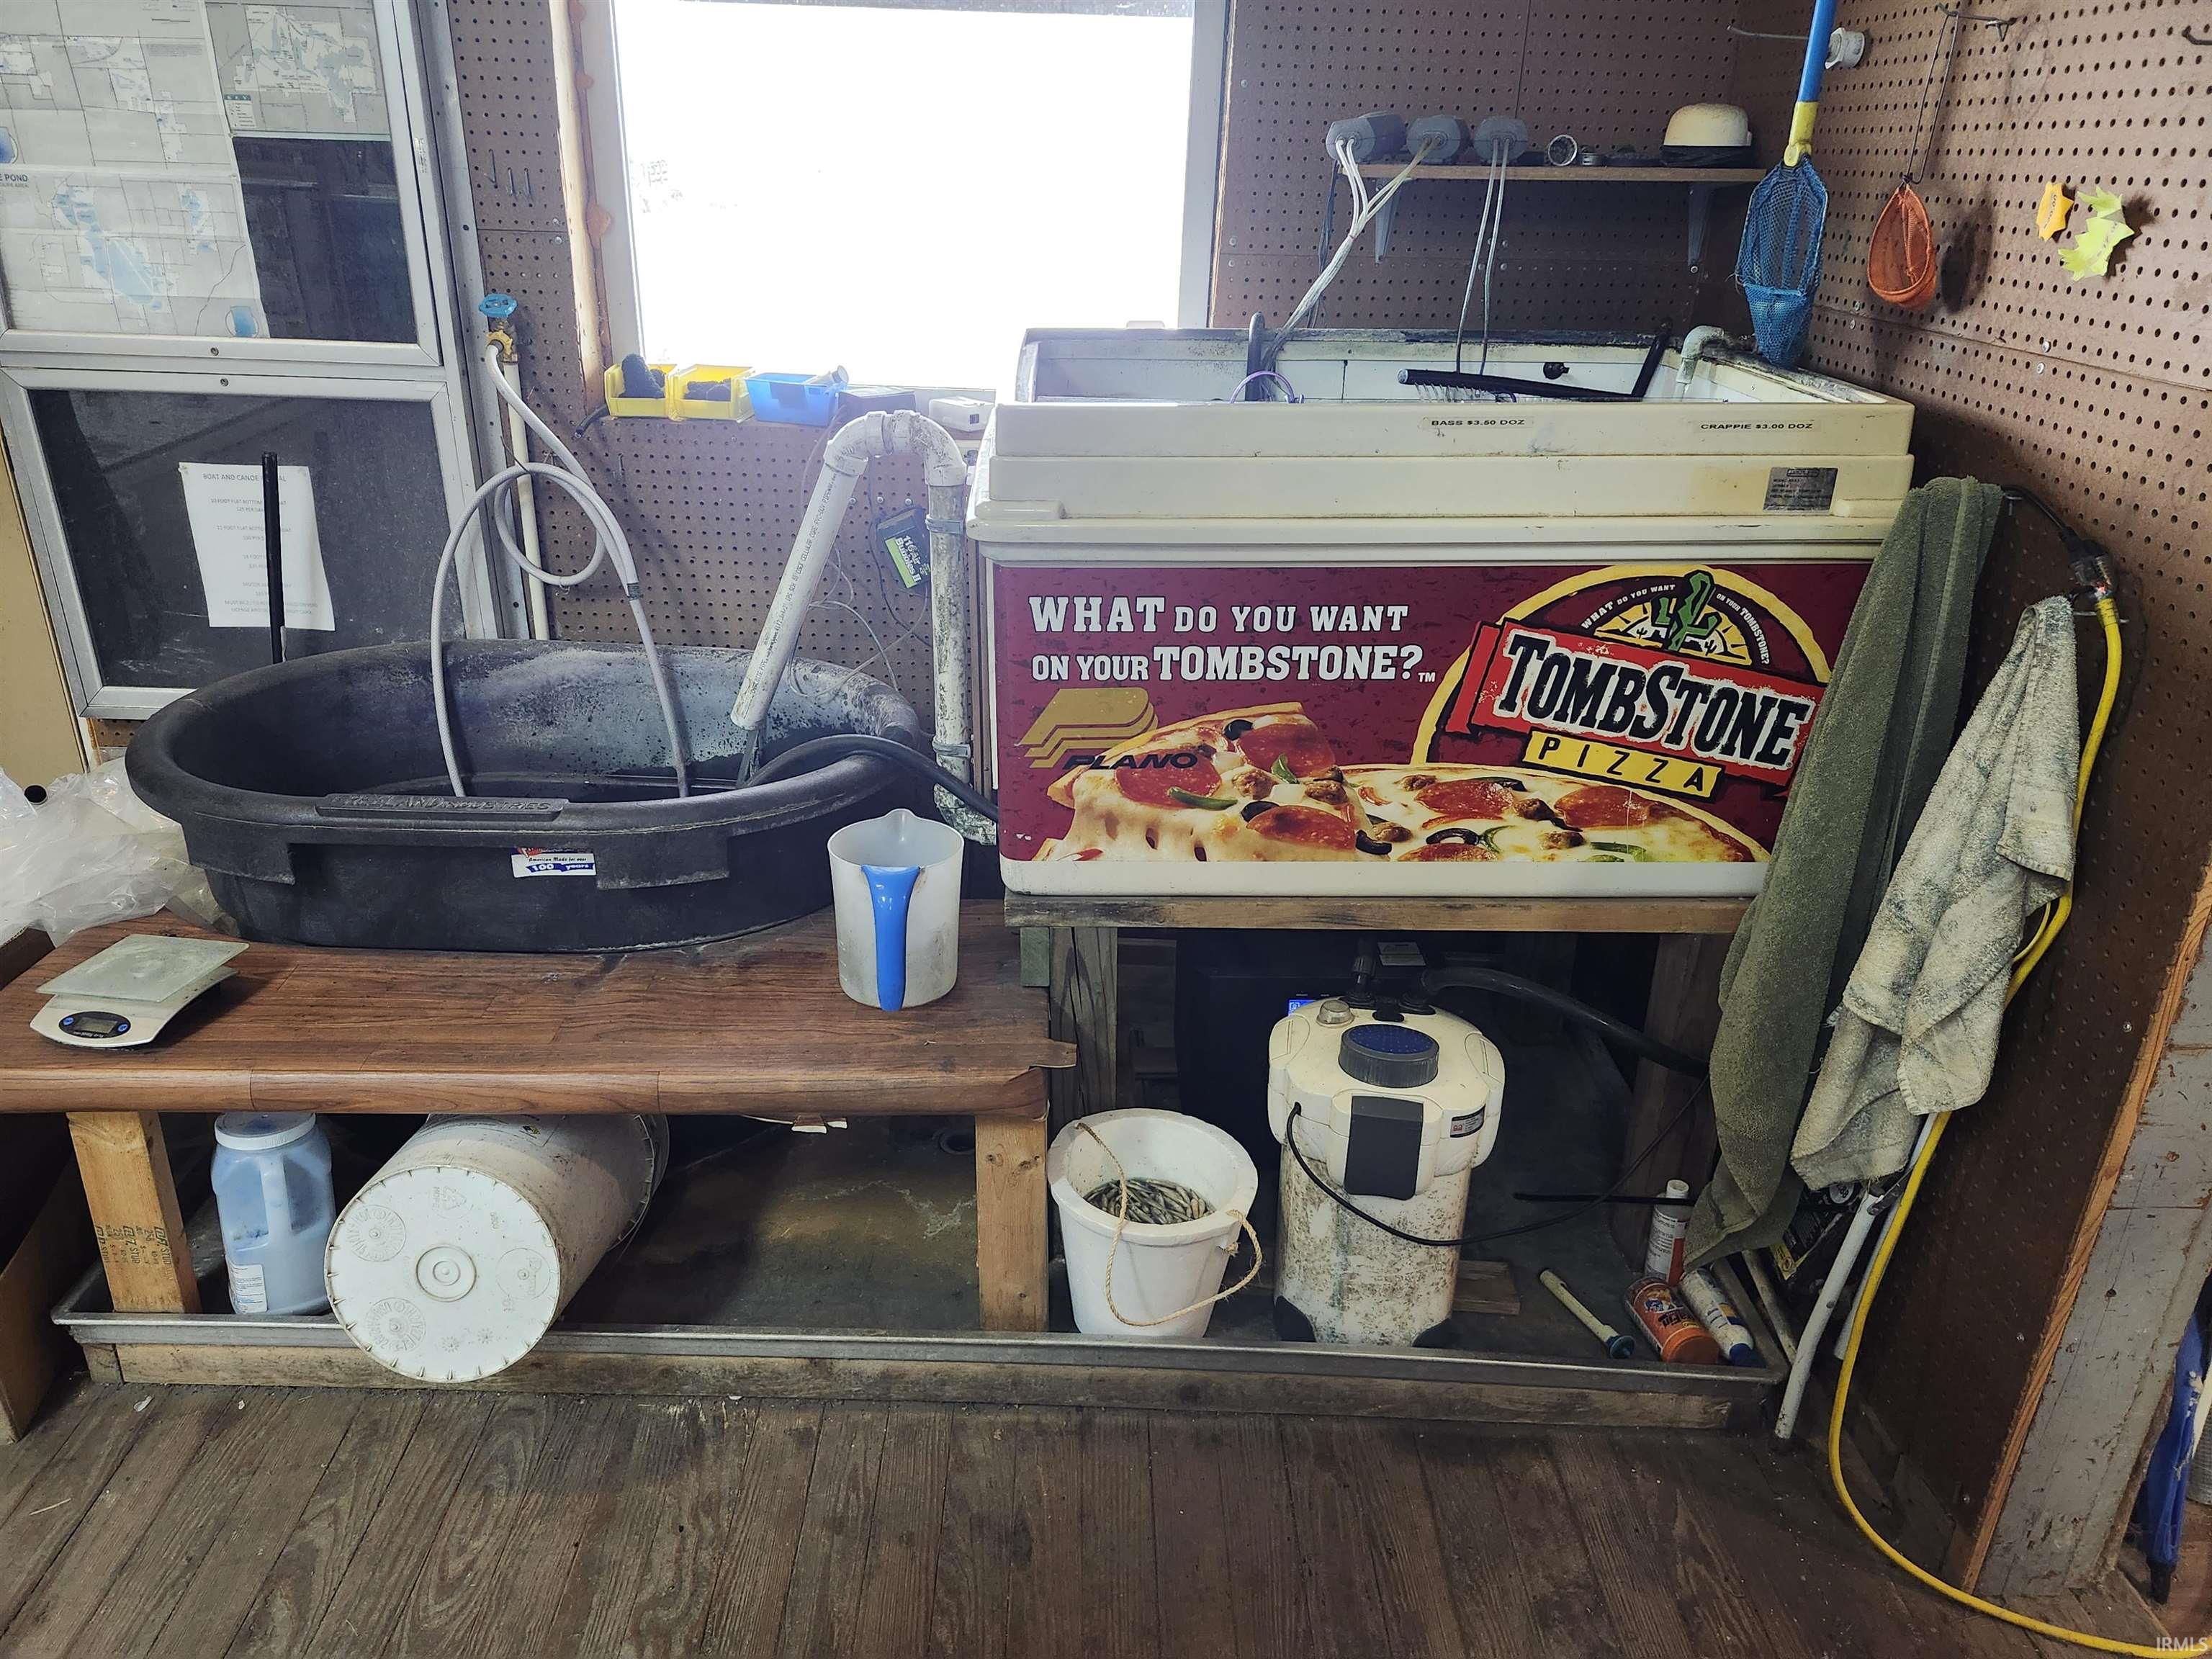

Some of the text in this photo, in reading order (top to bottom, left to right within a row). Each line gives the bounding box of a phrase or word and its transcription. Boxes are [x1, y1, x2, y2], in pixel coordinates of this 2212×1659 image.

[1028, 595, 1409, 633] WHAT DO YOU WANT
[1581, 584, 1771, 665] WHAT DO YOU WANT ON YOUR TOMBSTONE?
[1032, 655, 1070, 681] ON
[1076, 655, 1150, 681] YOUR
[1153, 644, 1424, 681] TOMBSTONE?
[1498, 633, 1812, 768] TOMBSTONE
[1062, 752, 1198, 770] PLANO
[1539, 736, 1707, 789] PIZZA
